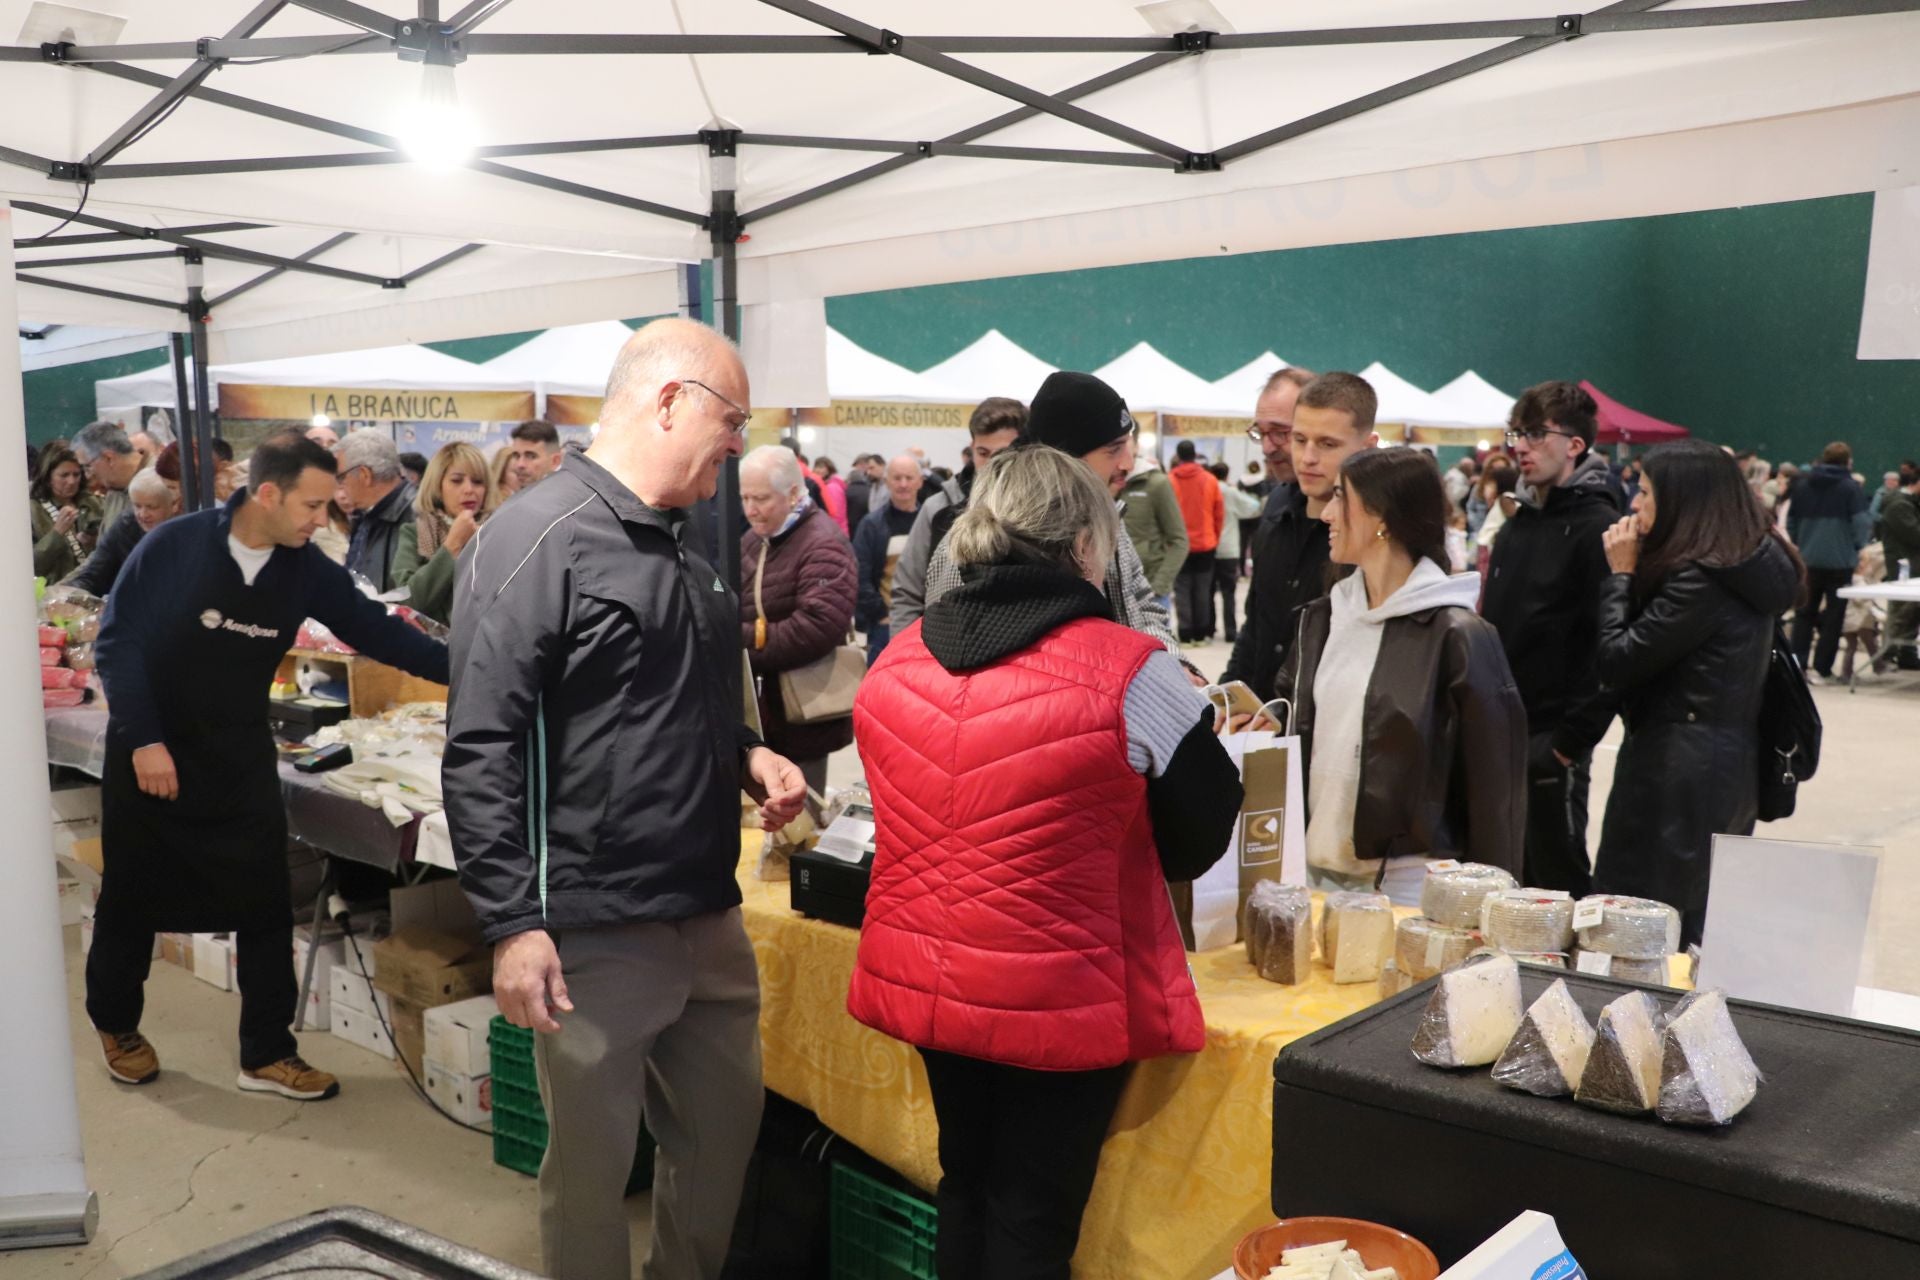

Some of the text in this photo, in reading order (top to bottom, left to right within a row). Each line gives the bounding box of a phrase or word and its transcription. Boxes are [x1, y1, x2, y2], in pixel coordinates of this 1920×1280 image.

[309, 390, 460, 419] LA BRAÑUCA
[834, 403, 962, 428] CAMPOS GÓTICOS
